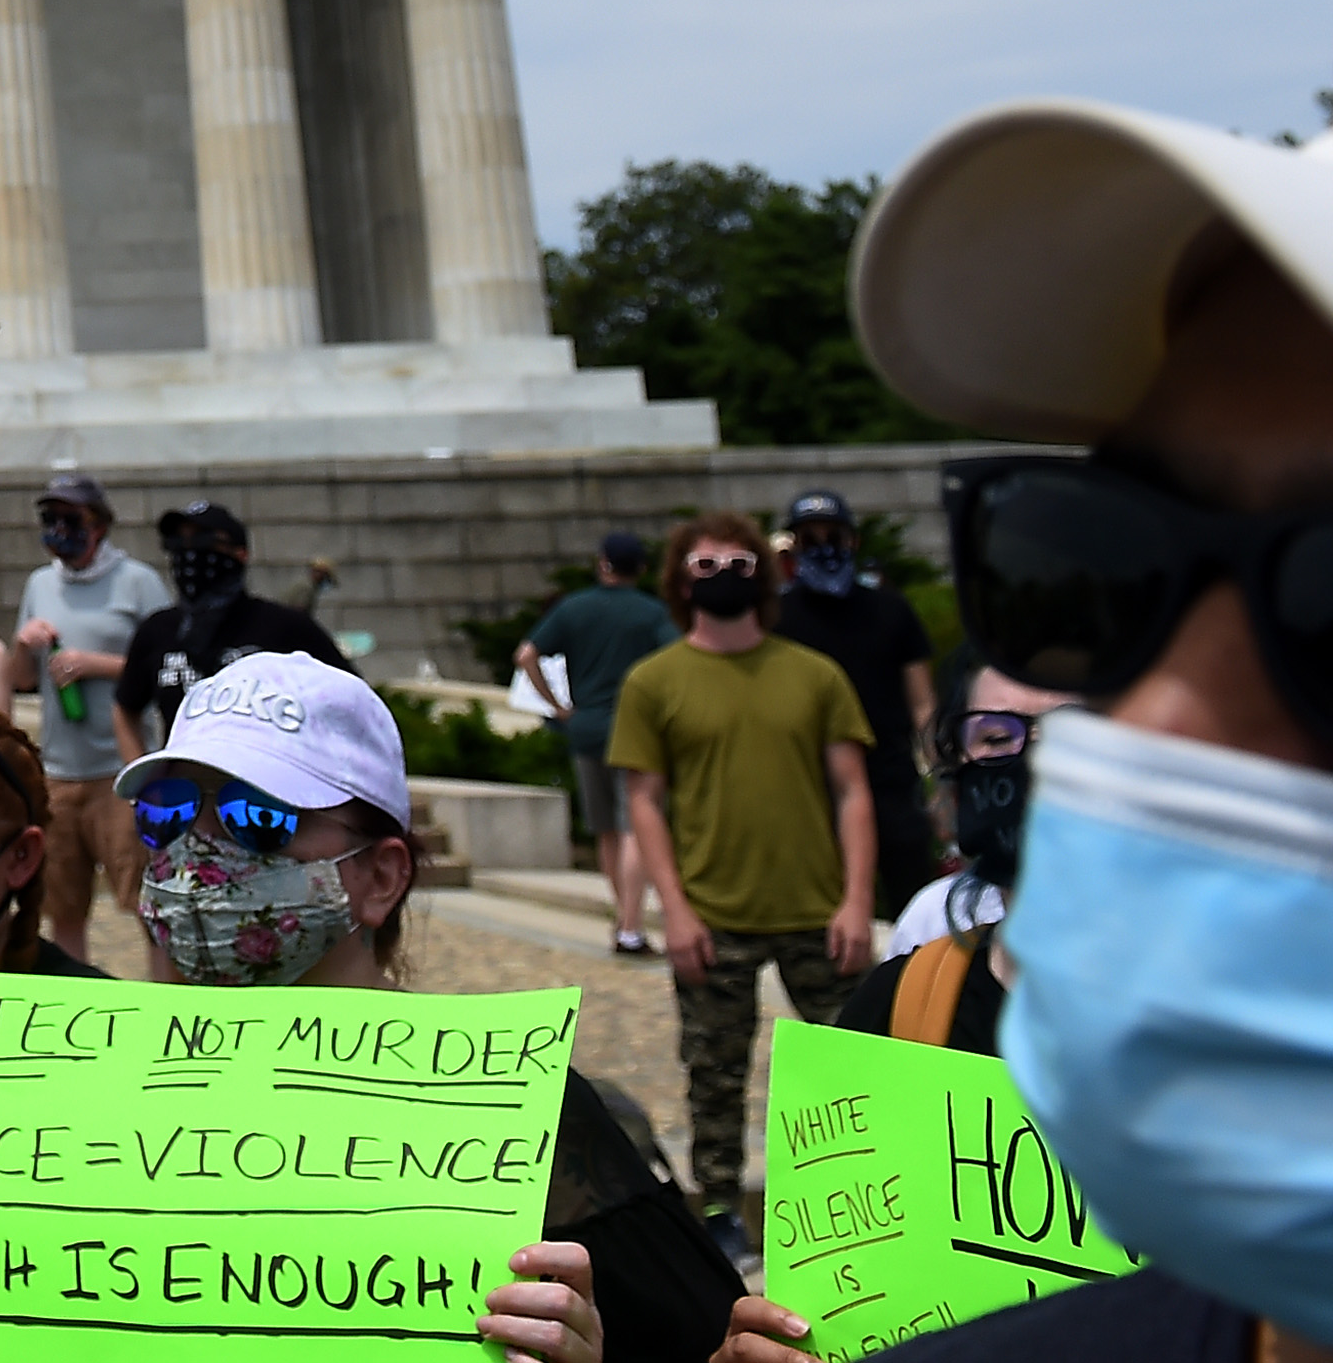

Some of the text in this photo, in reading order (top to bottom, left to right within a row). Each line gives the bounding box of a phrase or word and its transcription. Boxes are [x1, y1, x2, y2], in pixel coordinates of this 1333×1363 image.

[163, 1016, 263, 1058] NOT
[276, 1007, 574, 1078] MURDER!
[780, 1094, 871, 1157] WHITE
[773, 1174, 905, 1249] SILENCE
[62, 1239, 138, 1302] IS
[163, 1242, 481, 1313] ENOUGH!
[833, 1263, 861, 1294] IS
